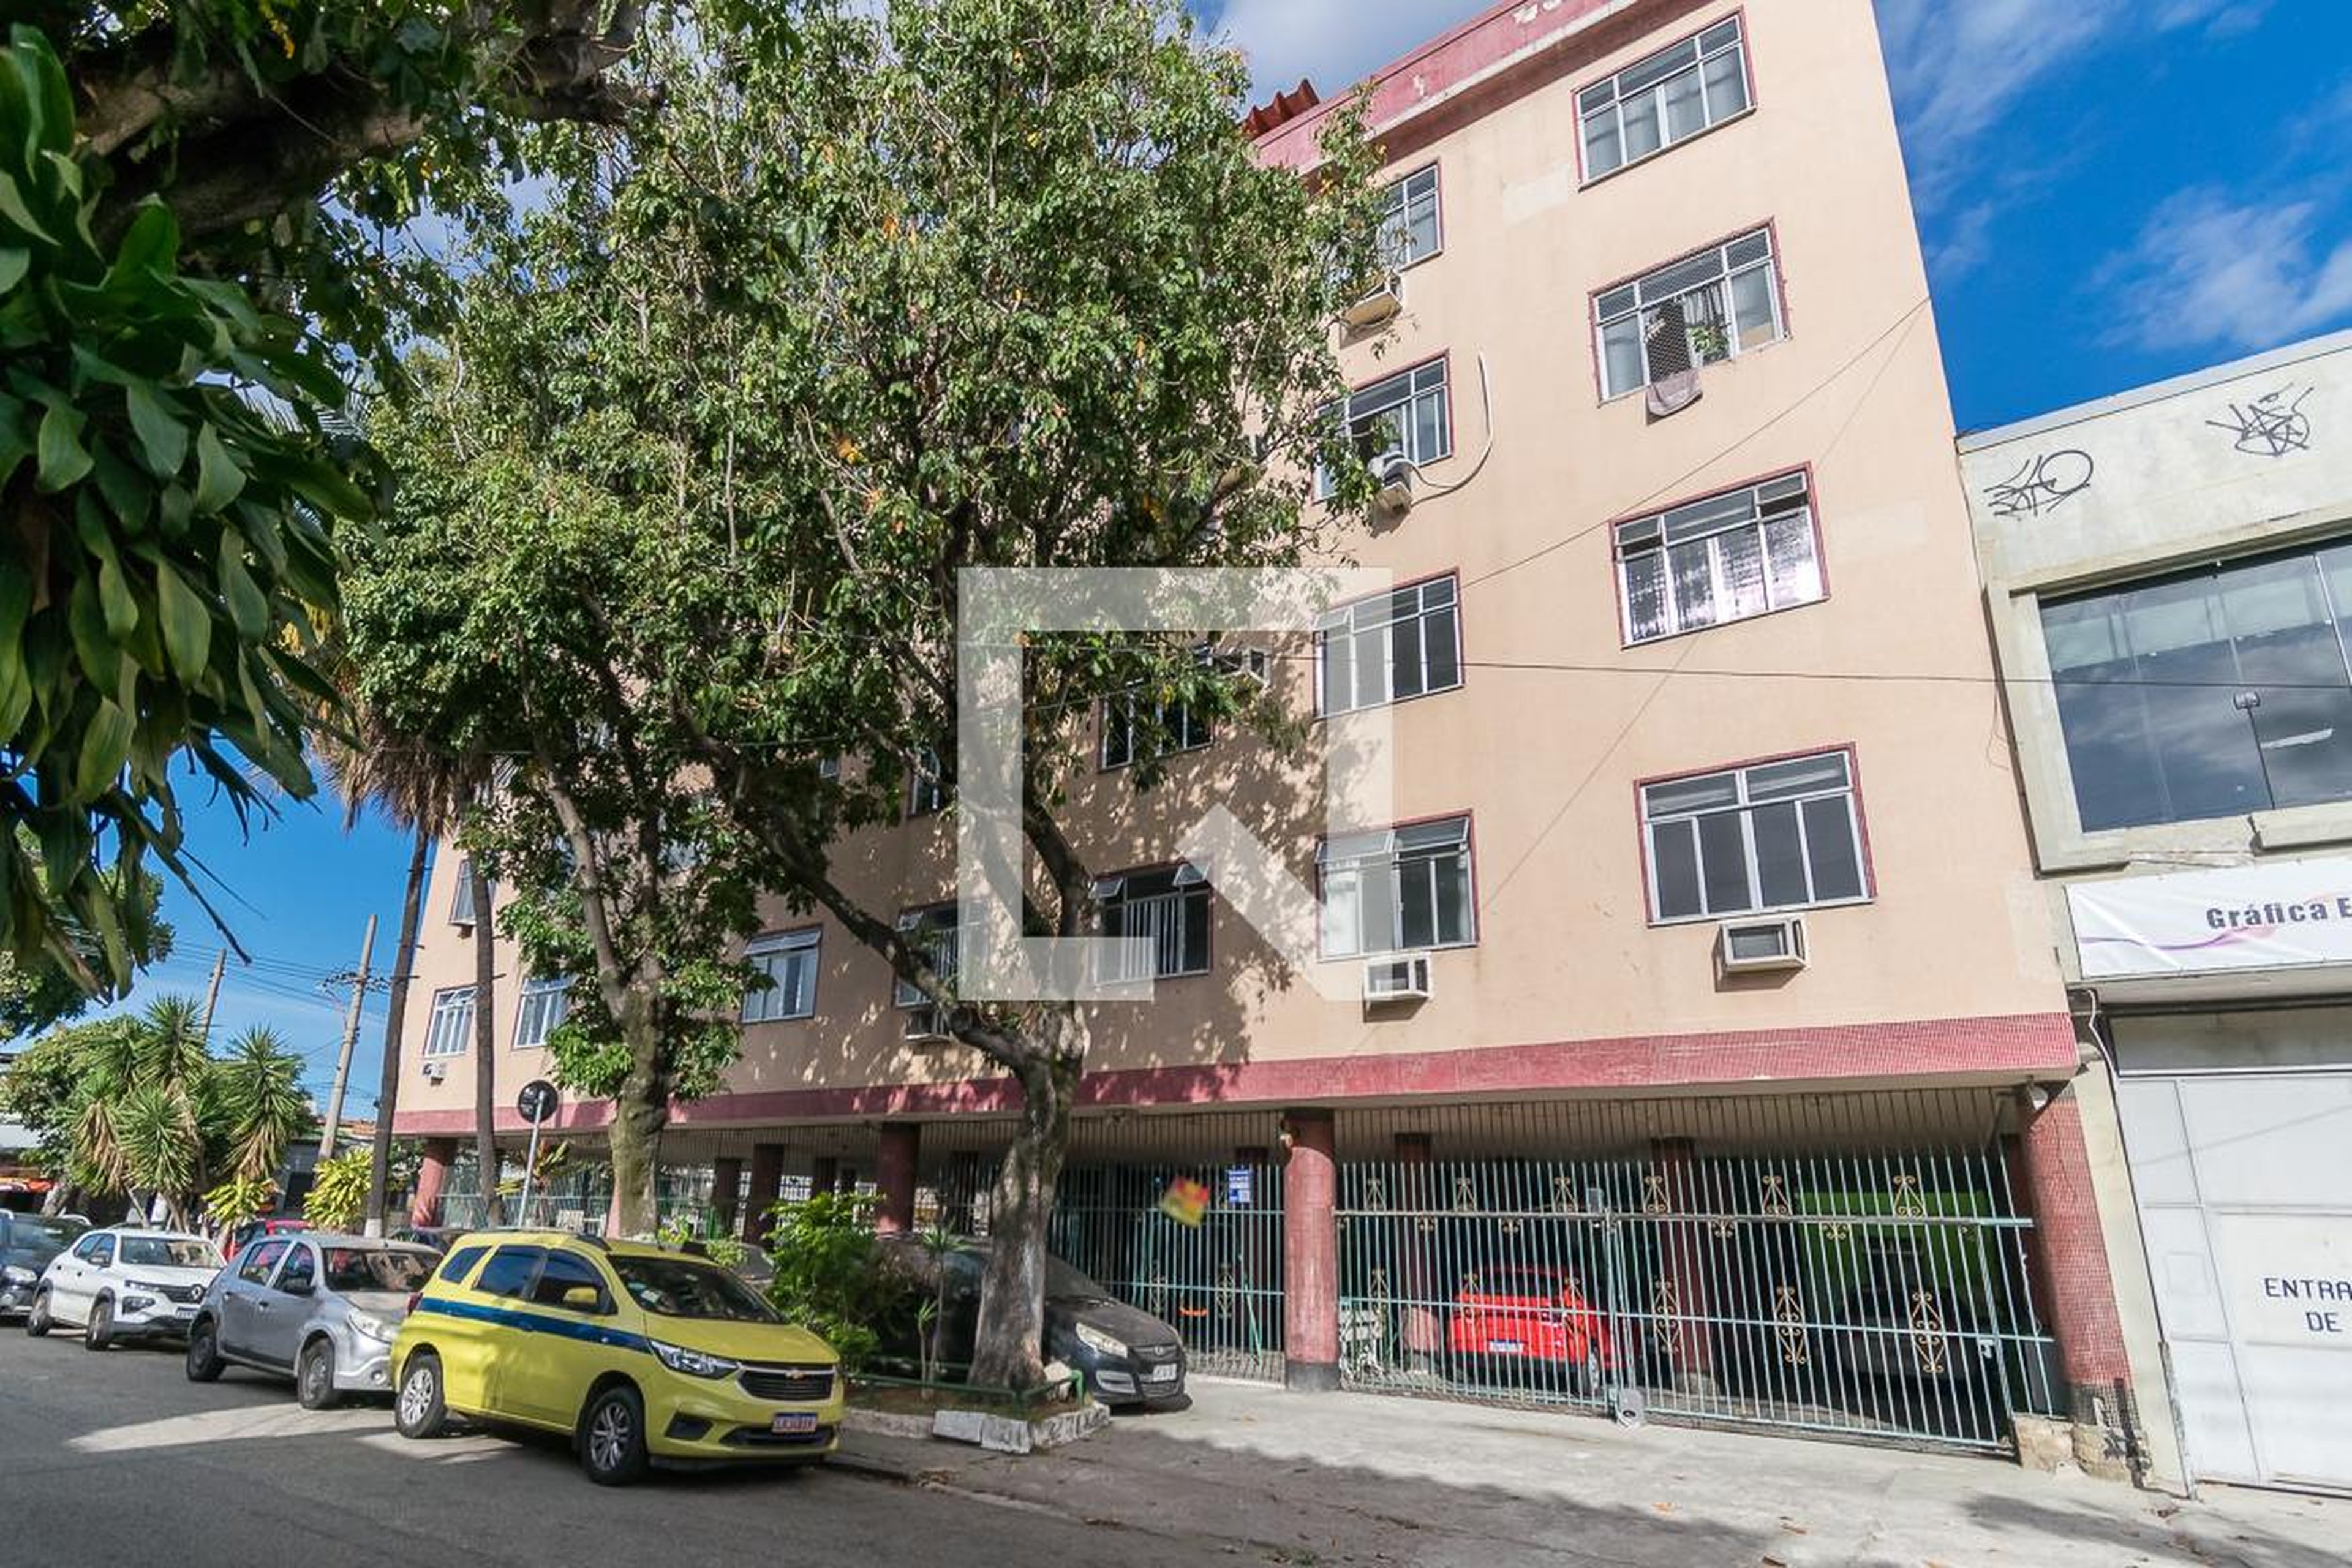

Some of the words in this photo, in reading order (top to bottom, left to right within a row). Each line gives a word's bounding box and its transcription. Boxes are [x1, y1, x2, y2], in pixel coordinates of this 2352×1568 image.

[2206, 902, 2329, 929] Gráfica
[2264, 1277, 2352, 1300] ENTRA
[2305, 1311, 2343, 1332] DE
